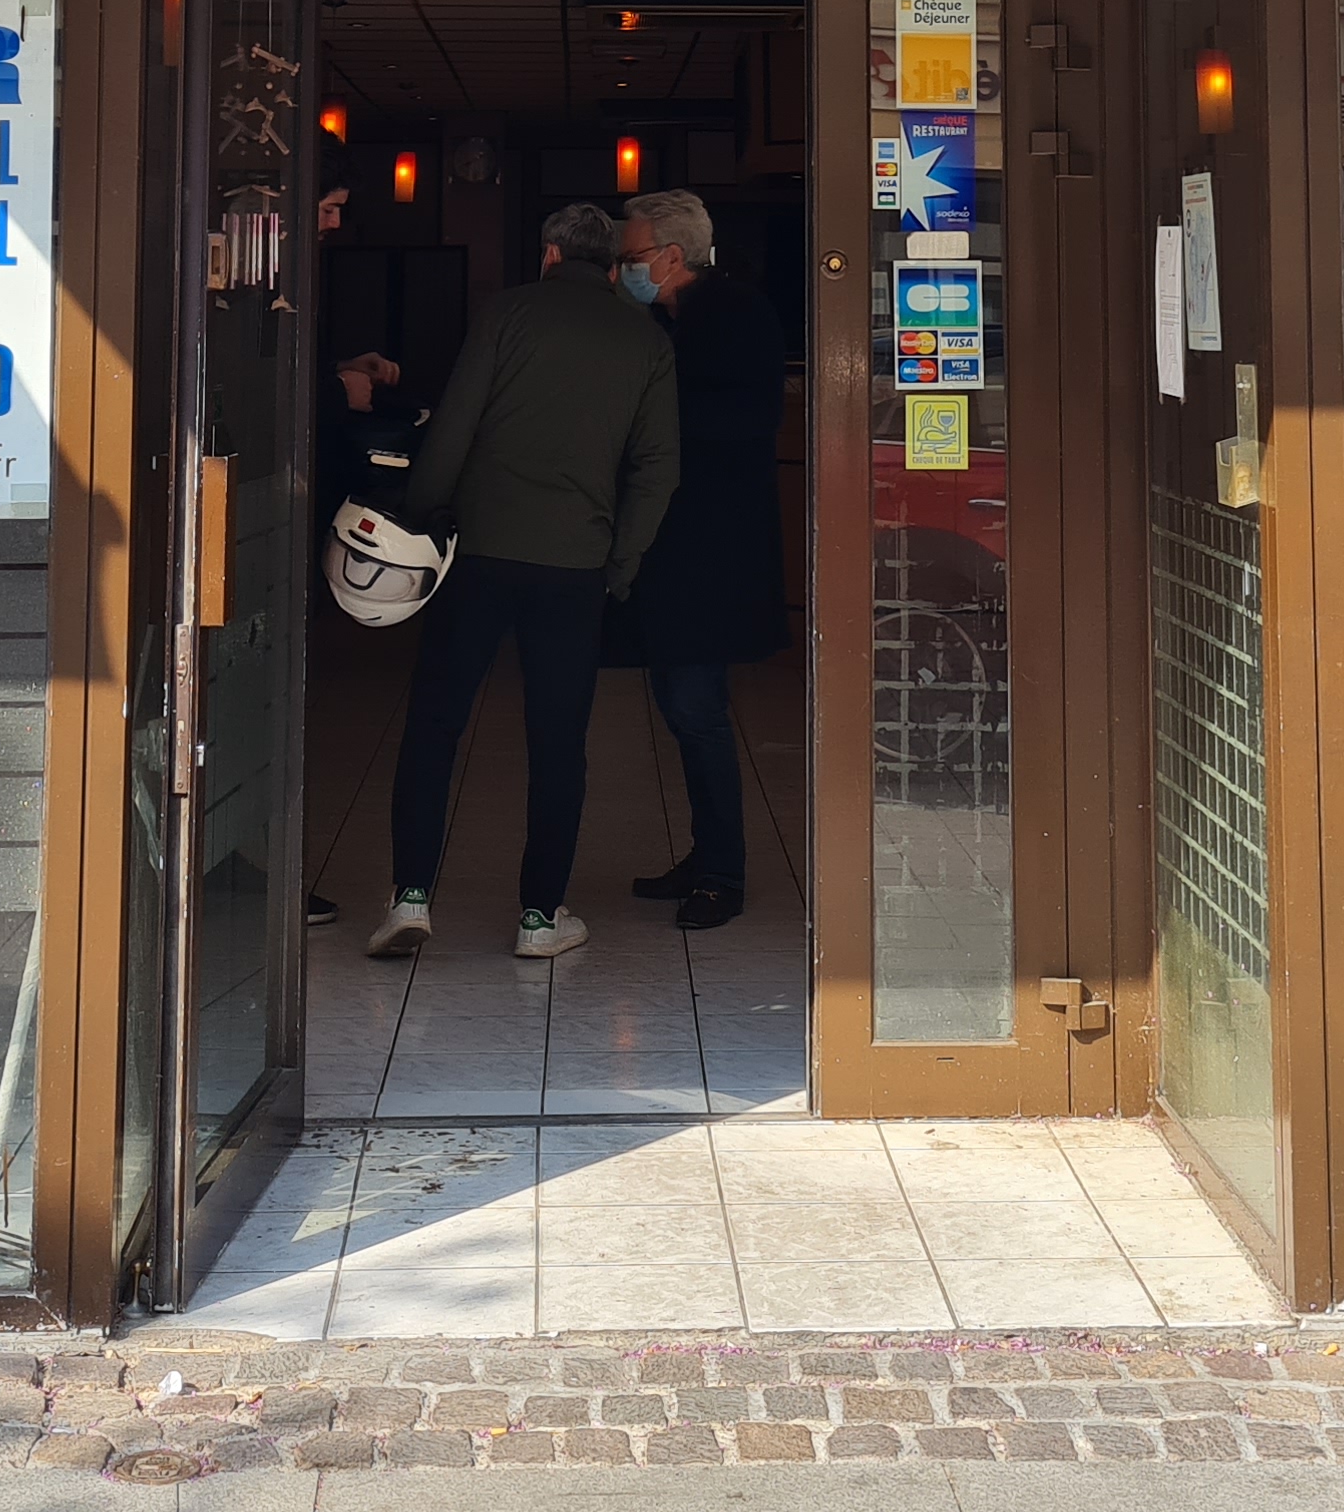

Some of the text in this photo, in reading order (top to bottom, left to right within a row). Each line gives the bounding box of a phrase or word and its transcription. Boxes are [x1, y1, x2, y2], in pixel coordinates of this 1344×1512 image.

[913, 0, 963, 13] Chèque
[914, 11, 971, 26] Déjeuner
[912, 125, 968, 137] RESTAURANT
[877, 179, 898, 188] VISA
[947, 337, 974, 348] VISA
[950, 360, 971, 369] VISA
[944, 372, 978, 381] Electron
